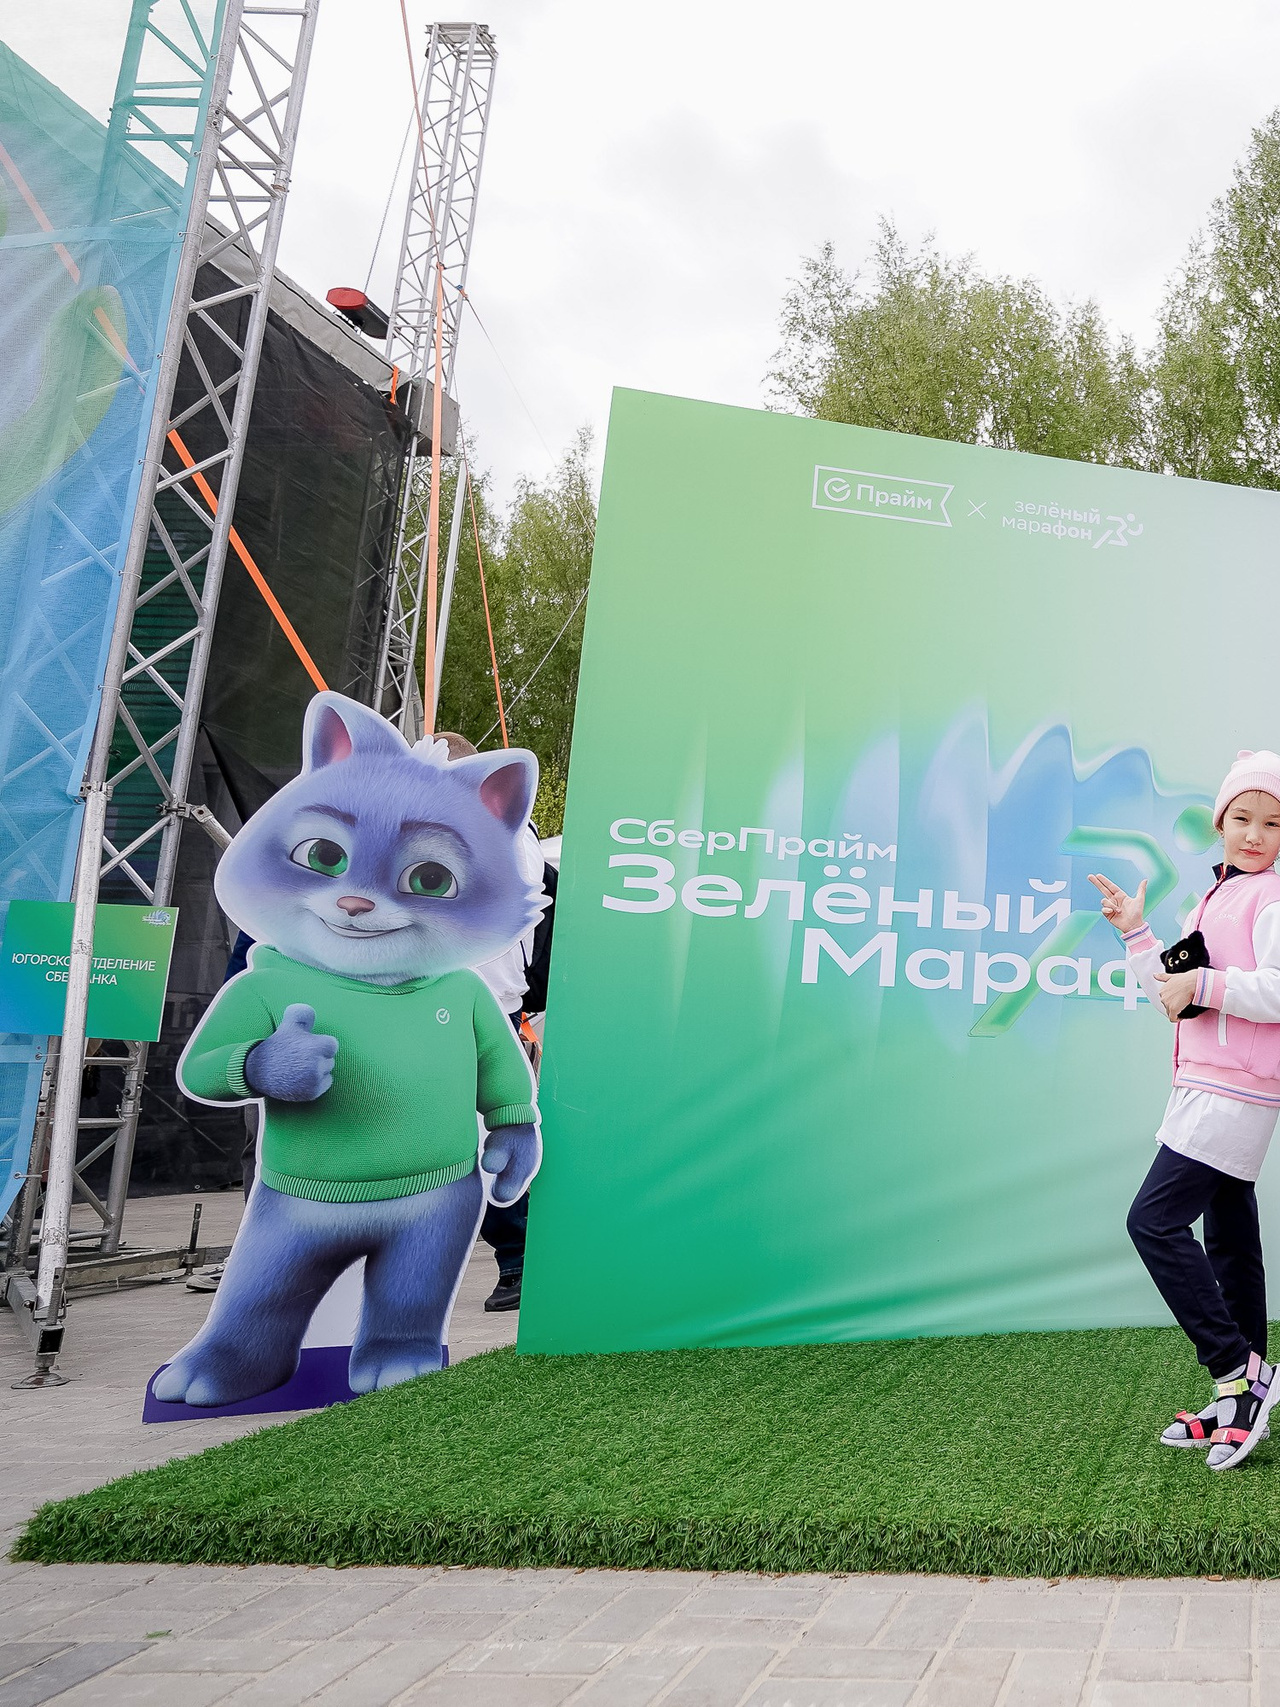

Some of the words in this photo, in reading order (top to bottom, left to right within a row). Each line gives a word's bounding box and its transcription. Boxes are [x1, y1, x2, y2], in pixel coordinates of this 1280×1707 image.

[856, 483, 933, 511] Прайм
[1013, 498, 1101, 526] зелёный
[1001, 515, 1093, 541] марафон
[608, 816, 898, 863] СберПрайм
[601, 851, 1073, 935] Зелёный
[11, 952, 72, 968] ЮГОРСКО
[92, 956, 157, 972] ТДЕЛЕНИЕ
[800, 927, 1146, 1012] Мараф
